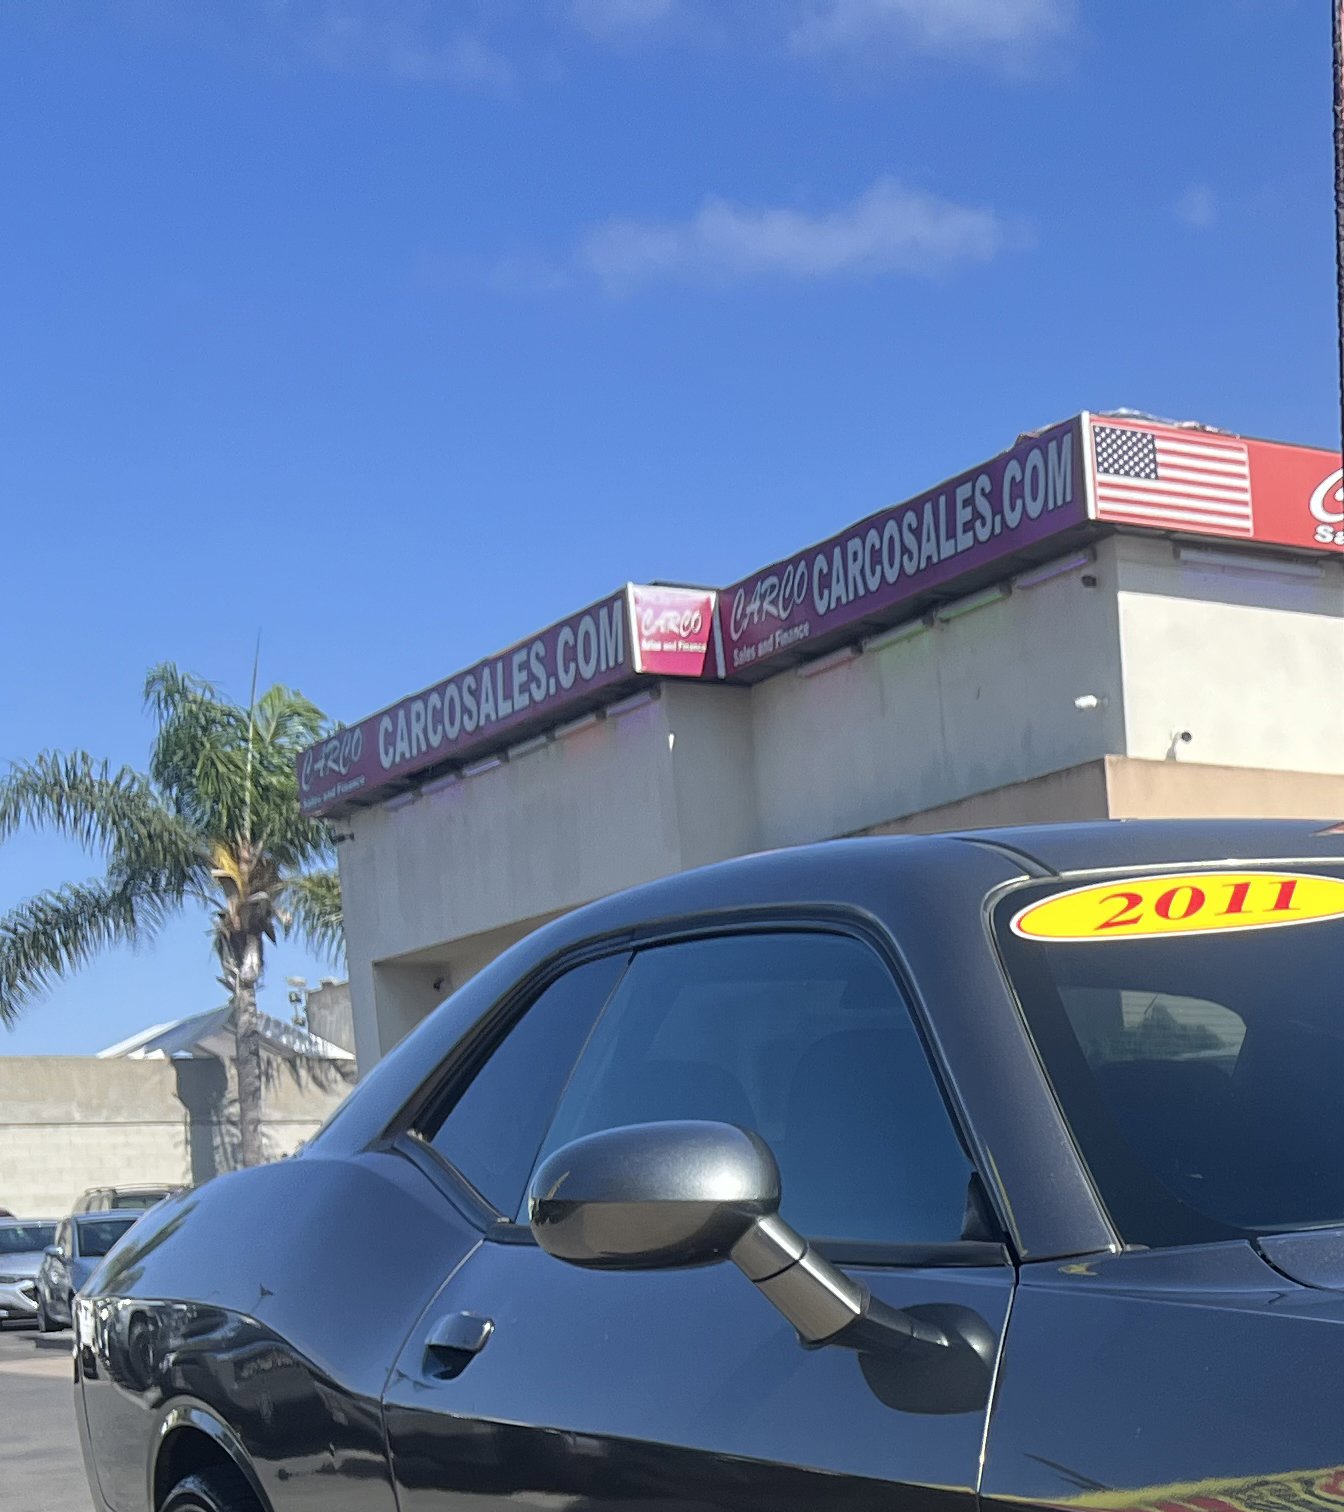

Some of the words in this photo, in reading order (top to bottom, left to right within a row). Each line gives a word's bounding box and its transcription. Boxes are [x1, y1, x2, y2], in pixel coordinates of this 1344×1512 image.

[813, 432, 1073, 616] CARCOSALES.COM
[641, 609, 702, 638] CARCO
[730, 560, 808, 641] CARCO
[757, 633, 775, 657] and
[775, 621, 810, 648] Finance
[379, 600, 624, 770] CARCOSALES.COM
[1094, 879, 1301, 932] 2011
